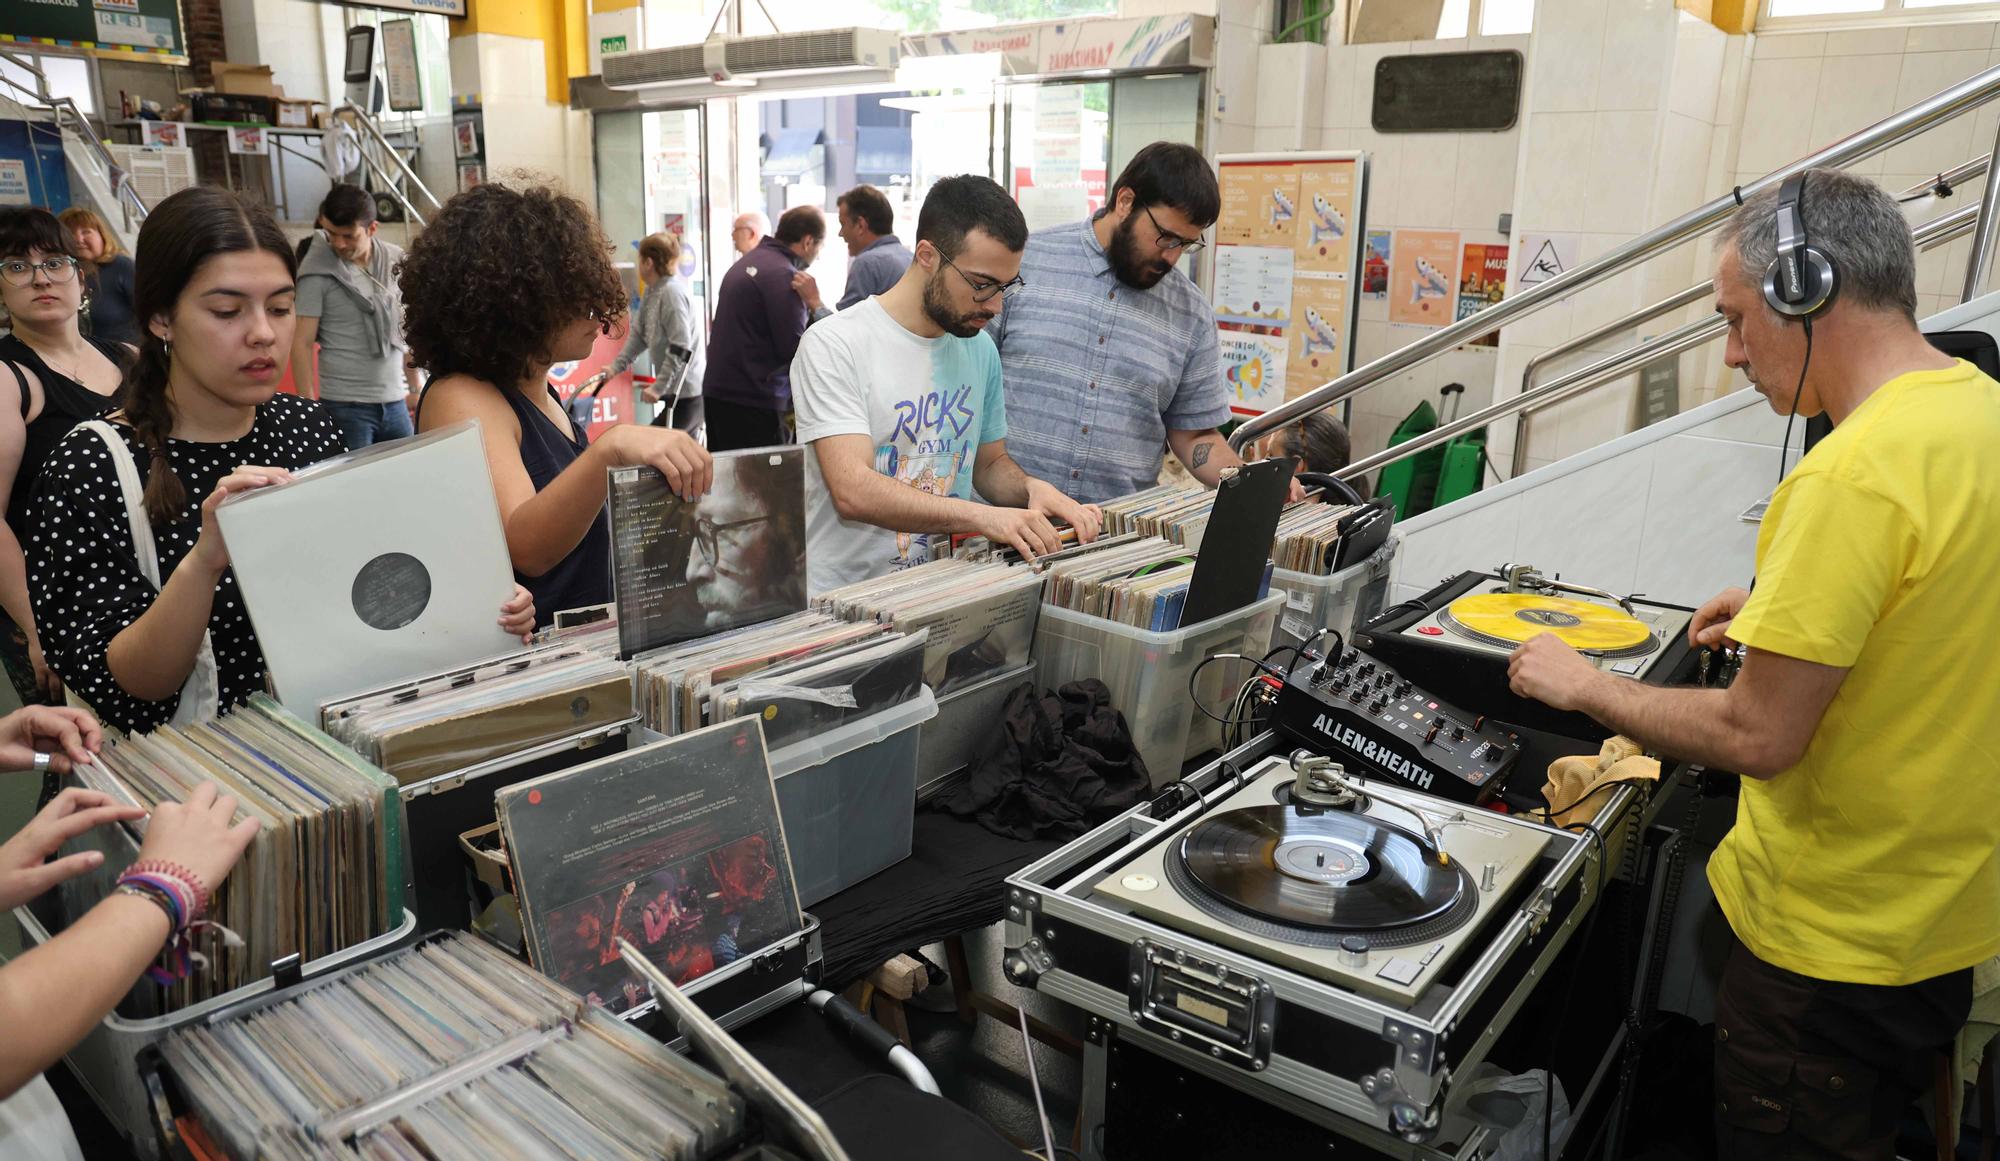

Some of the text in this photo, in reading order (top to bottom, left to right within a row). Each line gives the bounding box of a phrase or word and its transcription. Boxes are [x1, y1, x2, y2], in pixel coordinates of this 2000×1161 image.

[1788, 256, 1799, 293] Pioneer
[918, 439, 951, 454] GYM
[1312, 713, 1435, 790] ALLEN&HEATH
